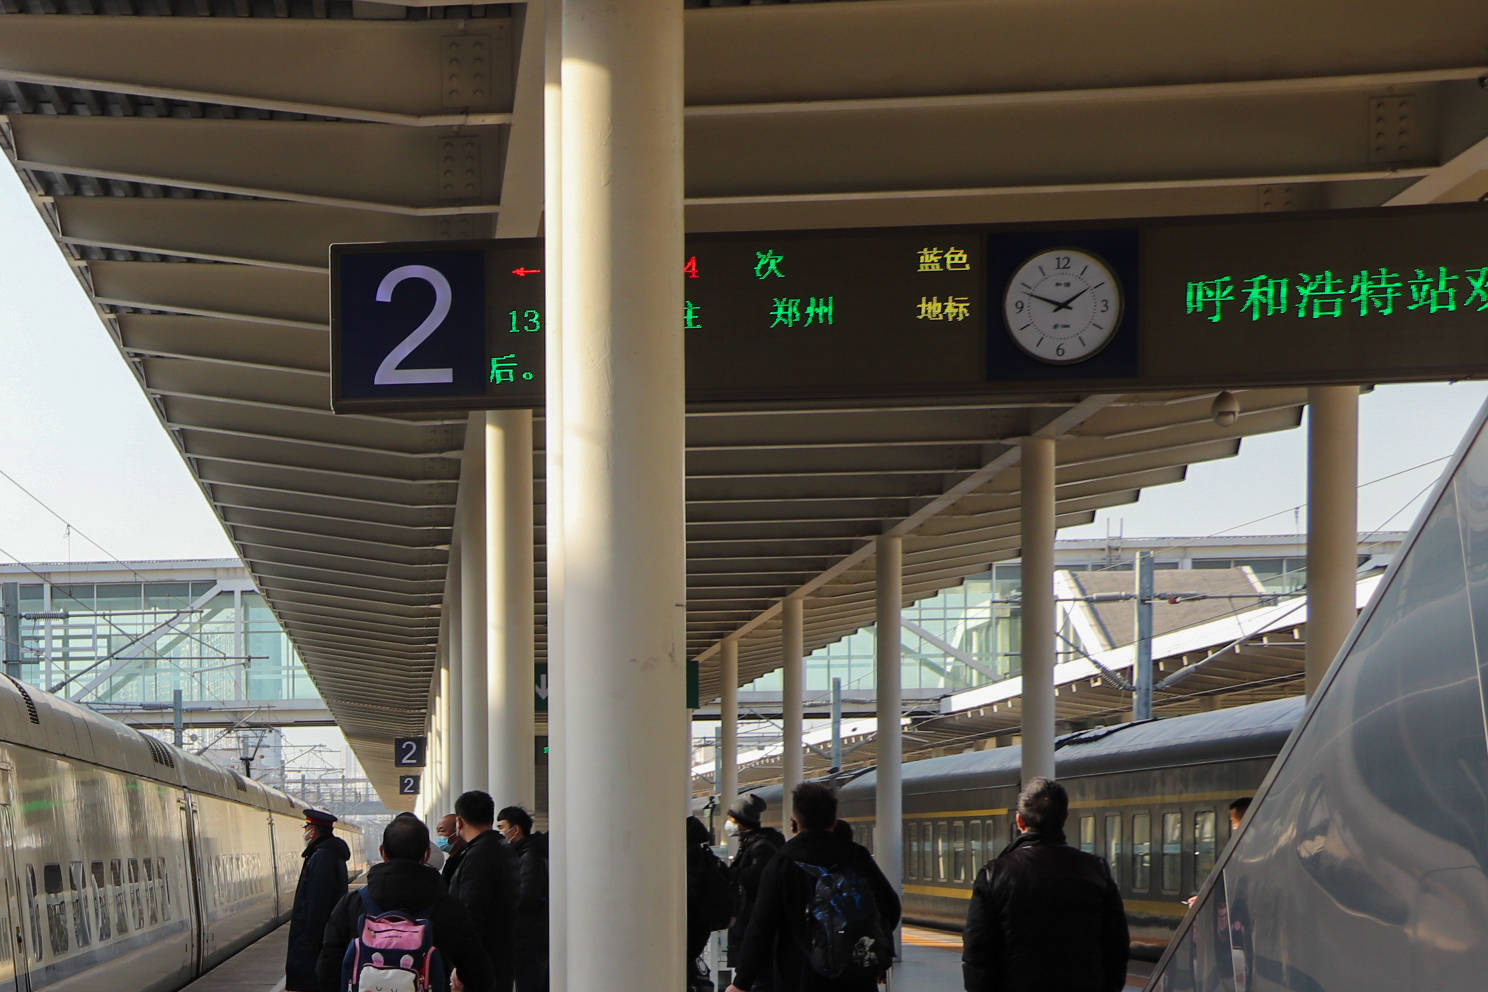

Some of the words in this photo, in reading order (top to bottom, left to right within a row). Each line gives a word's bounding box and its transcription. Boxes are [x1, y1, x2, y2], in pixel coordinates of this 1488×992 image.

[753, 249, 786, 280] 次
[916, 246, 971, 272] 蓝色
[1055, 256, 1072, 270] 12
[508, 309, 542, 333] 13
[769, 296, 834, 329] 郑州
[915, 295, 971, 322] 地标
[1015, 300, 1025, 315] 9
[1100, 299, 1110, 313] 3
[374, 264, 454, 385] 2
[1056, 343, 1066, 357] 6
[402, 741, 417, 764] 2
[404, 777, 415, 793] 2
